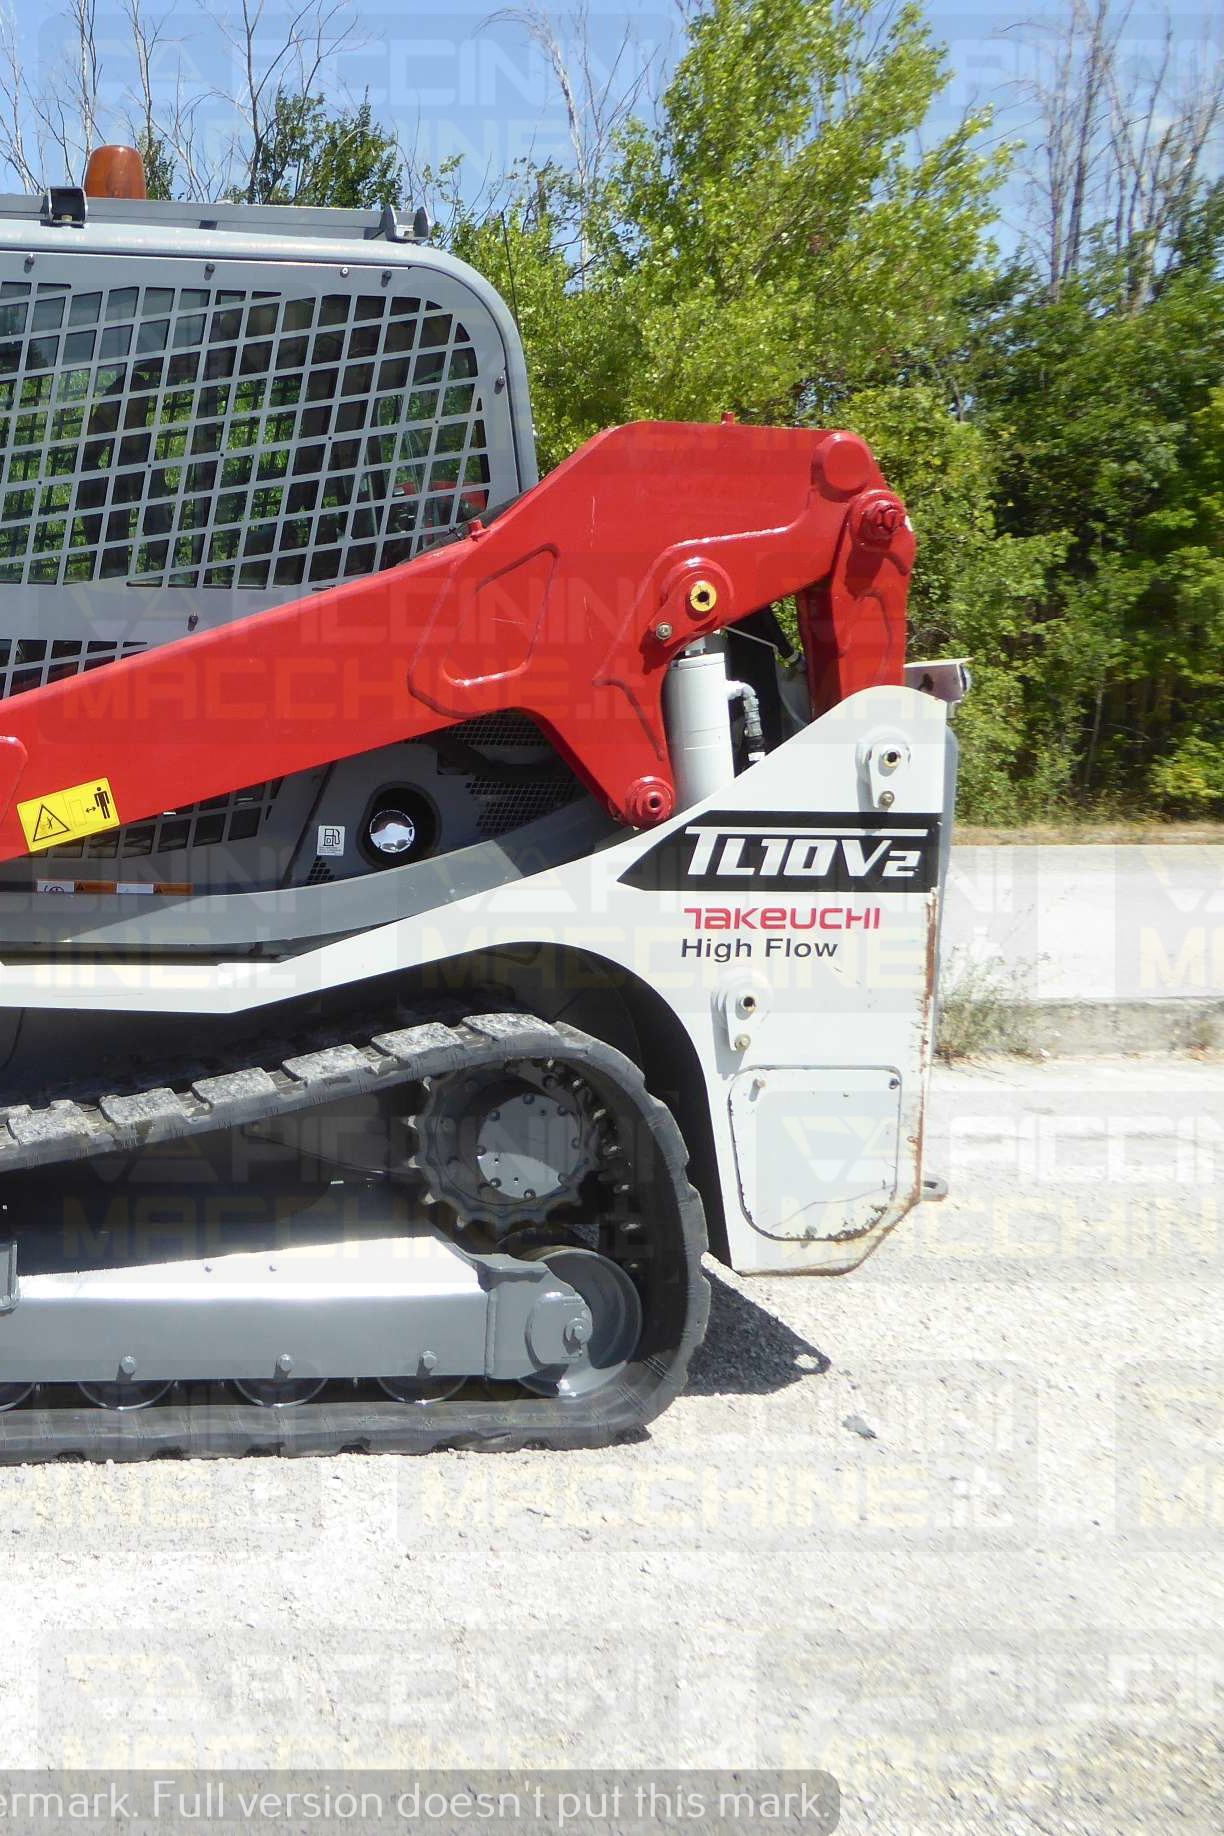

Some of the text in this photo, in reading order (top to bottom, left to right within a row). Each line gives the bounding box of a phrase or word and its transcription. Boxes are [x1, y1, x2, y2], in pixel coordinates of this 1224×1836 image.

[684, 907, 880, 930] TAKEUCHI
[681, 938, 838, 963] High Flow
